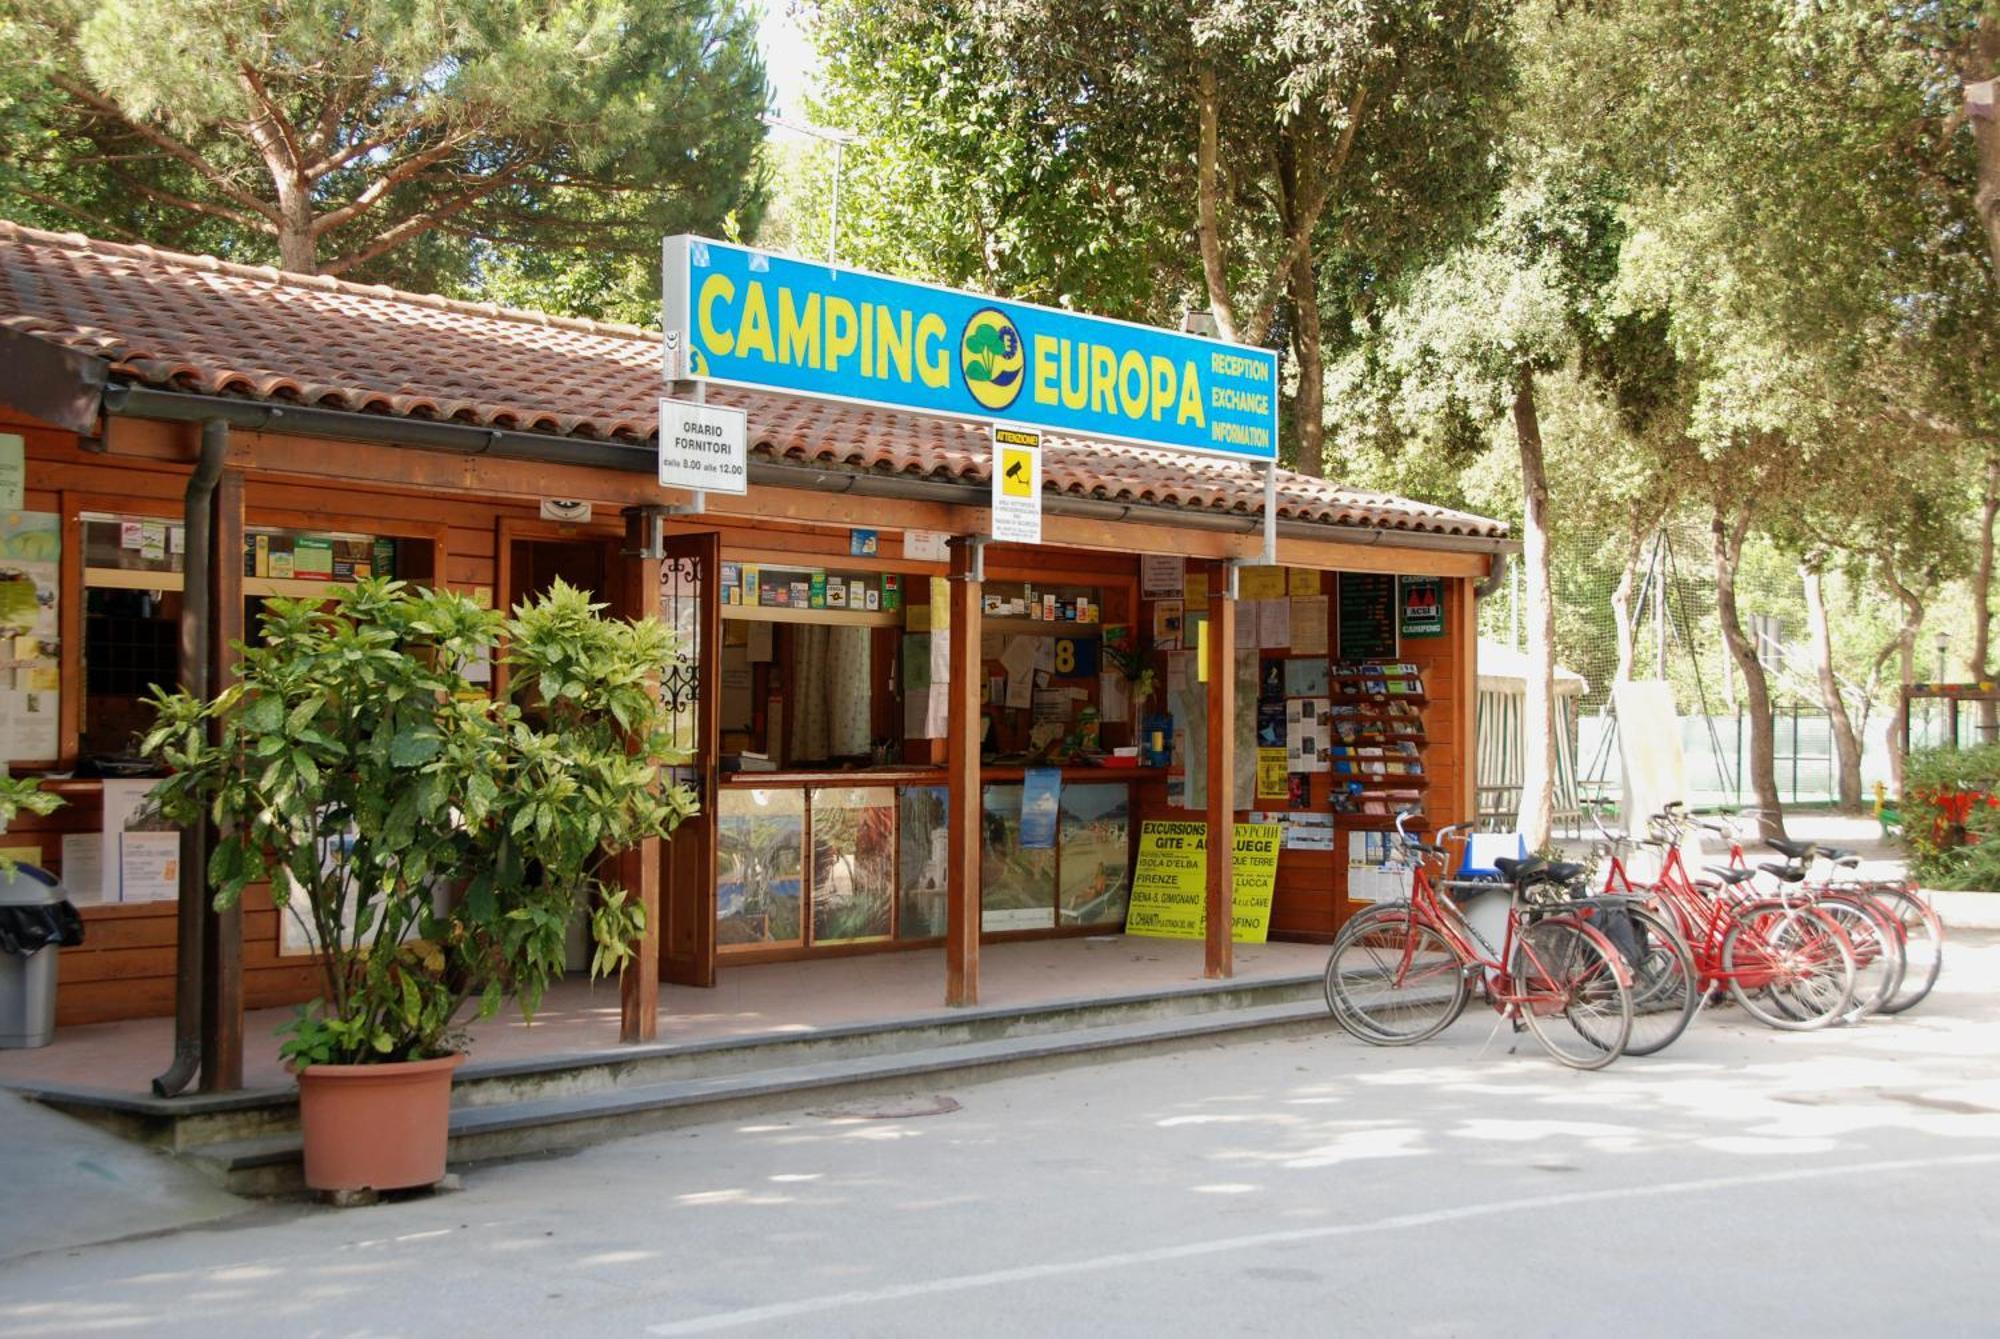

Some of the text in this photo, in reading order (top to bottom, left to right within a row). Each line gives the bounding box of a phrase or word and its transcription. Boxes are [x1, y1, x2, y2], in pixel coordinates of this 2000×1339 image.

[698, 273, 1206, 428] CAMPING EUROPA
[1212, 352, 1269, 382] RECEPTION
[1212, 386, 1269, 415] EXCHANGE
[683, 422, 722, 437] ORARIO
[1212, 421, 1270, 449] INFORMATION
[675, 437, 732, 455] FORNITORI
[683, 459, 701, 470] 8.00
[719, 464, 744, 475] 12.00
[1402, 625, 1441, 633] CAMPING
[1056, 640, 1075, 673] 8
[1143, 822, 1206, 836] EXCURSIONS
[1156, 837, 1184, 849] GITE
[1250, 857, 1274, 867] TERRE
[1136, 874, 1179, 885] FIRENZE
[1236, 878, 1268, 888] LUCCA
